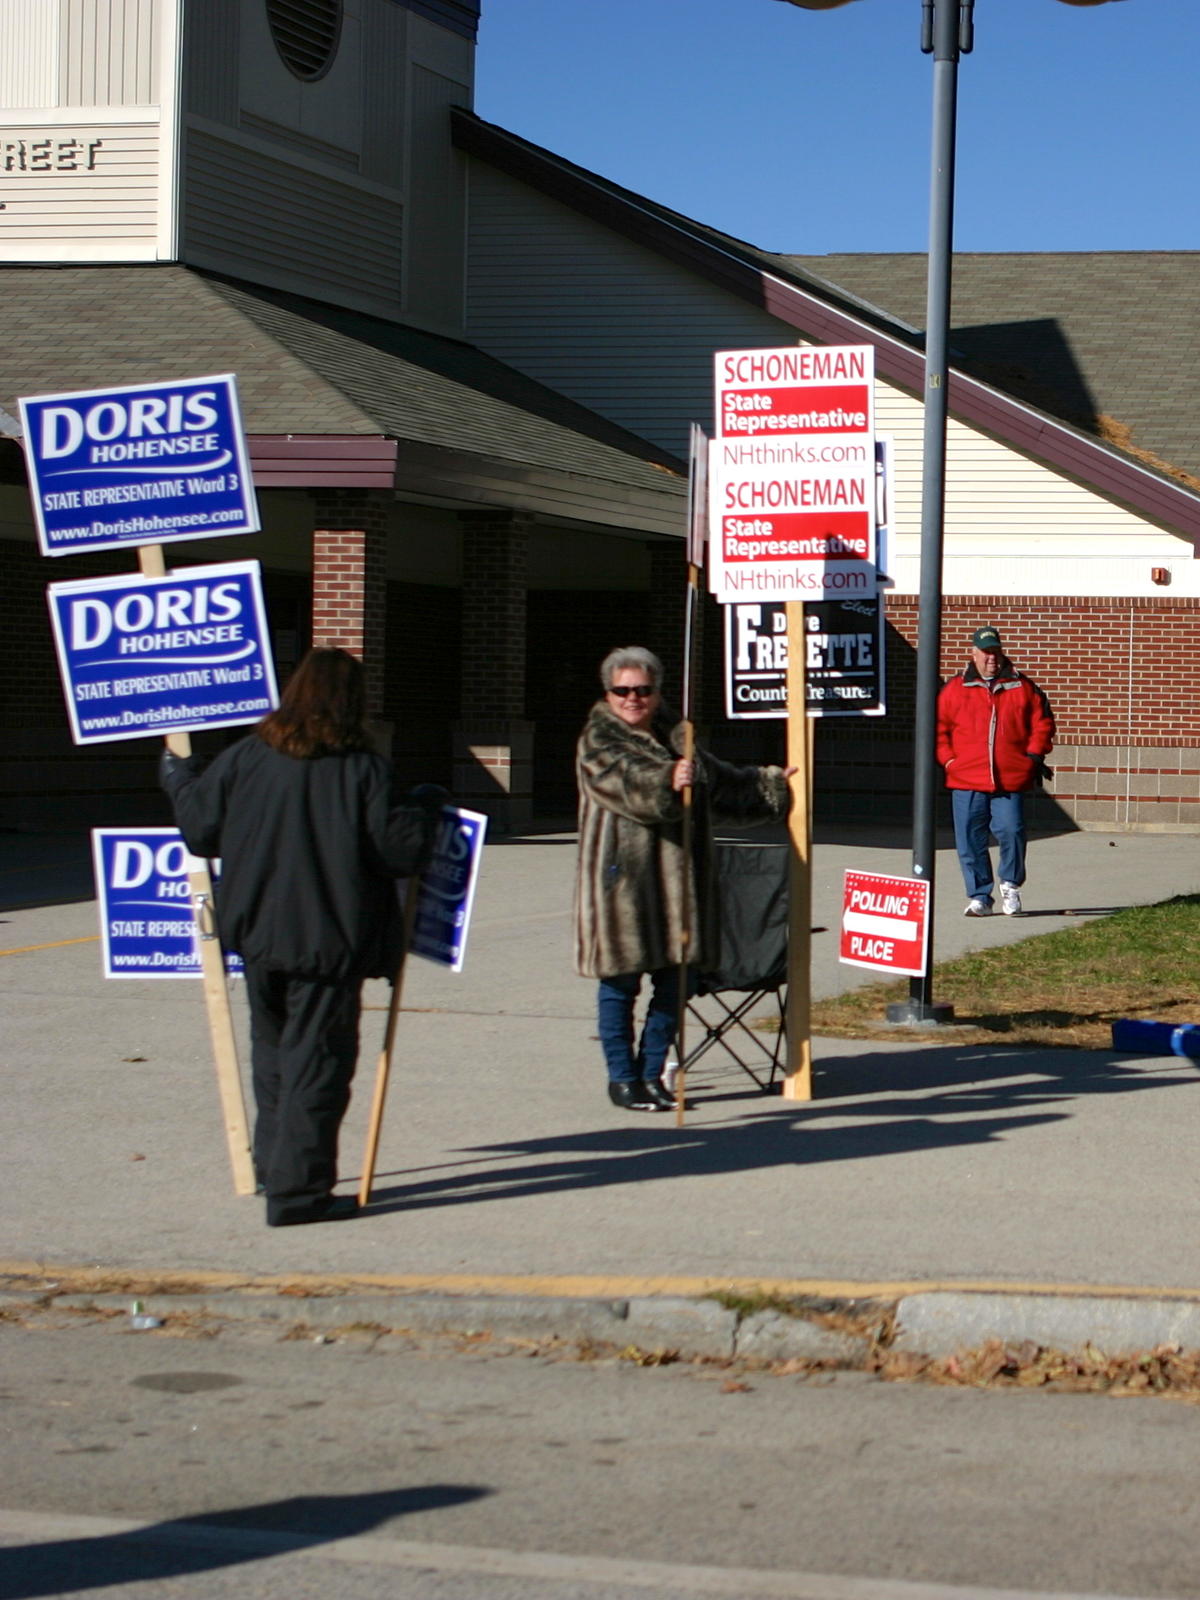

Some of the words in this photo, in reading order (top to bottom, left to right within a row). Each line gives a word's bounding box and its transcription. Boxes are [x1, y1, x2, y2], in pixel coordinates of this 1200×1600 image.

[0, 139, 103, 170] REET
[724, 352, 865, 384] SCHONEMAN
[724, 393, 772, 411] State
[41, 391, 219, 460] DORIS
[725, 408, 866, 435] Representative
[91, 433, 220, 463] HOHENSEE
[724, 442, 866, 465] NHthinks.com
[44, 491, 81, 511] STATE
[84, 480, 184, 507] REPRESENTATIVE
[188, 475, 225, 495] Ward
[228, 473, 238, 491] 3
[725, 478, 865, 509] SCHONEMAN
[50, 509, 243, 541] www.DorisHohensee.com
[725, 518, 773, 537] State
[725, 535, 866, 560] Representative
[724, 568, 867, 591] NHthinks.com
[70, 583, 242, 650] DORIS
[773, 612, 820, 633] De
[119, 624, 244, 654] HOHENSEE
[736, 604, 873, 670] FREETTE
[76, 682, 111, 702] STATE
[114, 670, 211, 697] REPRESENTATIVE
[214, 666, 250, 686] Ward
[254, 663, 263, 681] 3
[736, 684, 789, 702] Count
[82, 698, 269, 731] www.DorisHohensee.com
[851, 890, 909, 916] POLLING
[111, 921, 145, 937] STATE
[850, 936, 895, 961] PLACE
